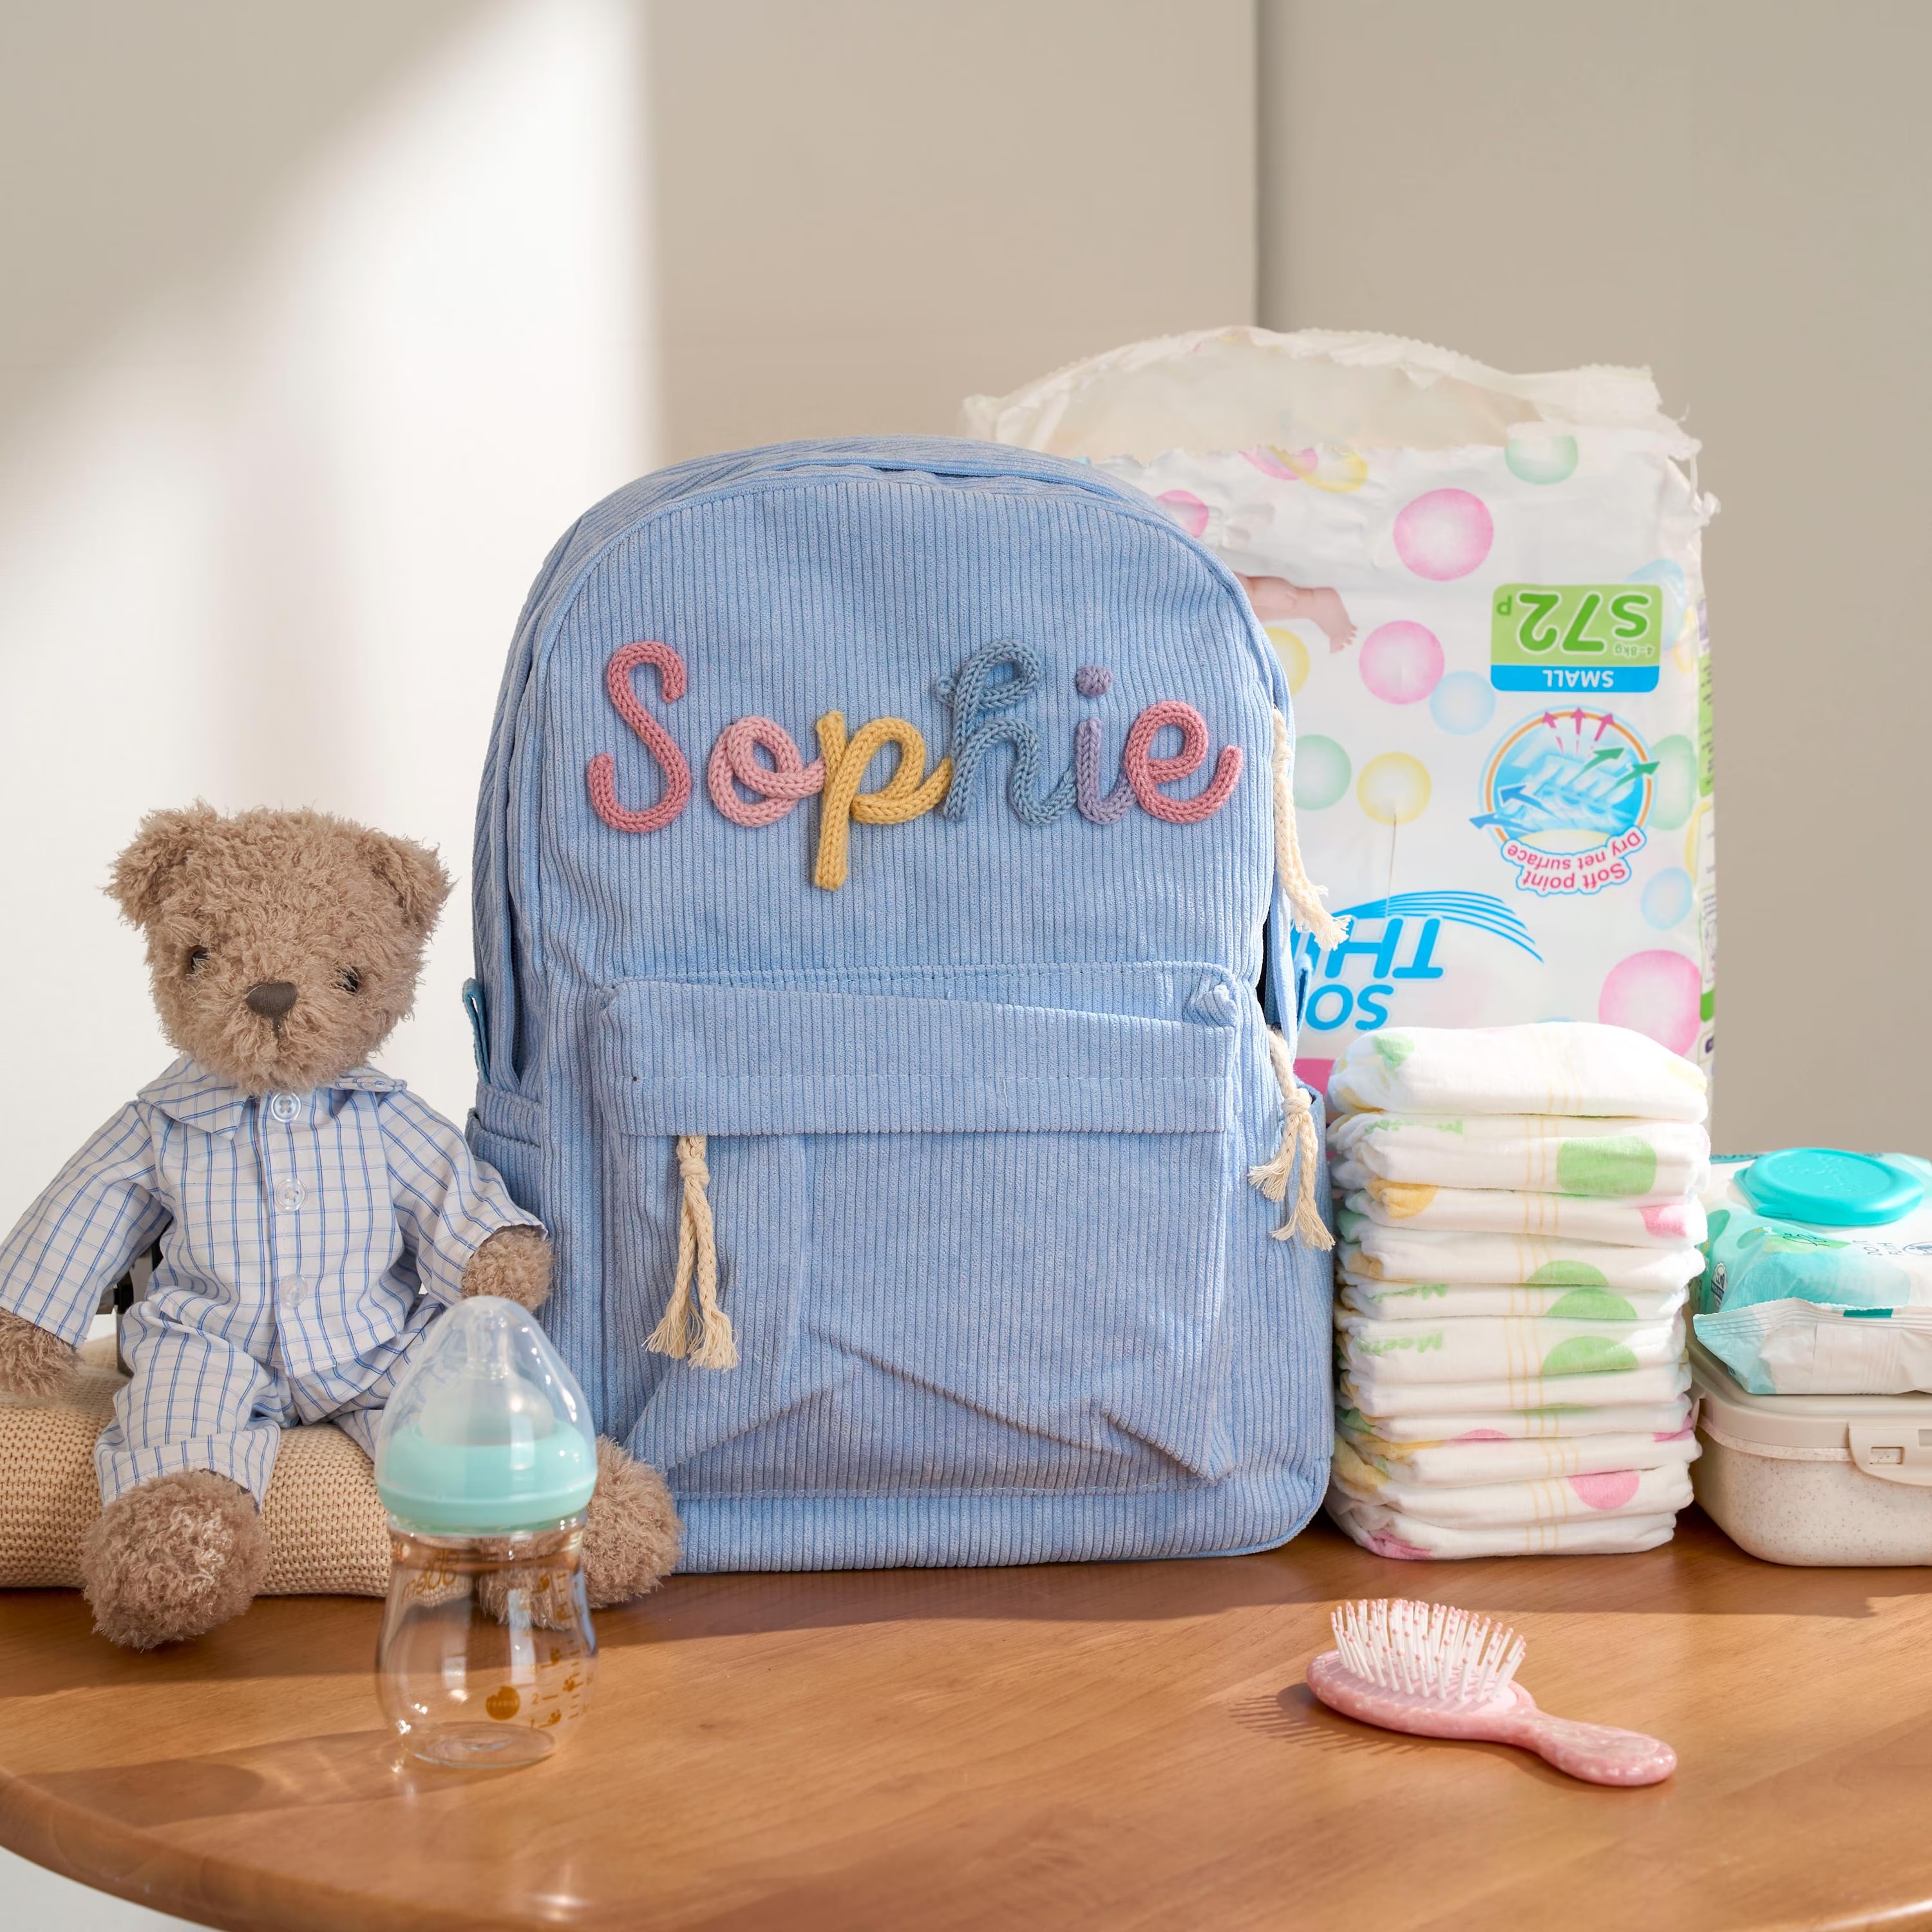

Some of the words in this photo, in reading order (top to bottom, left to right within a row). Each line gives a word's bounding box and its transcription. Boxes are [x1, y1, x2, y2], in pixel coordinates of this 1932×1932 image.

[1542, 669, 1615, 688] SMALL
[589, 639, 1243, 890] Sophie
[1507, 844, 1571, 870] surface
[1611, 831, 1641, 857] Dry
[1577, 851, 1606, 870] net
[1522, 870, 1575, 891] point
[1582, 862, 1625, 889] Soft
[1305, 984, 1395, 1031] SO
